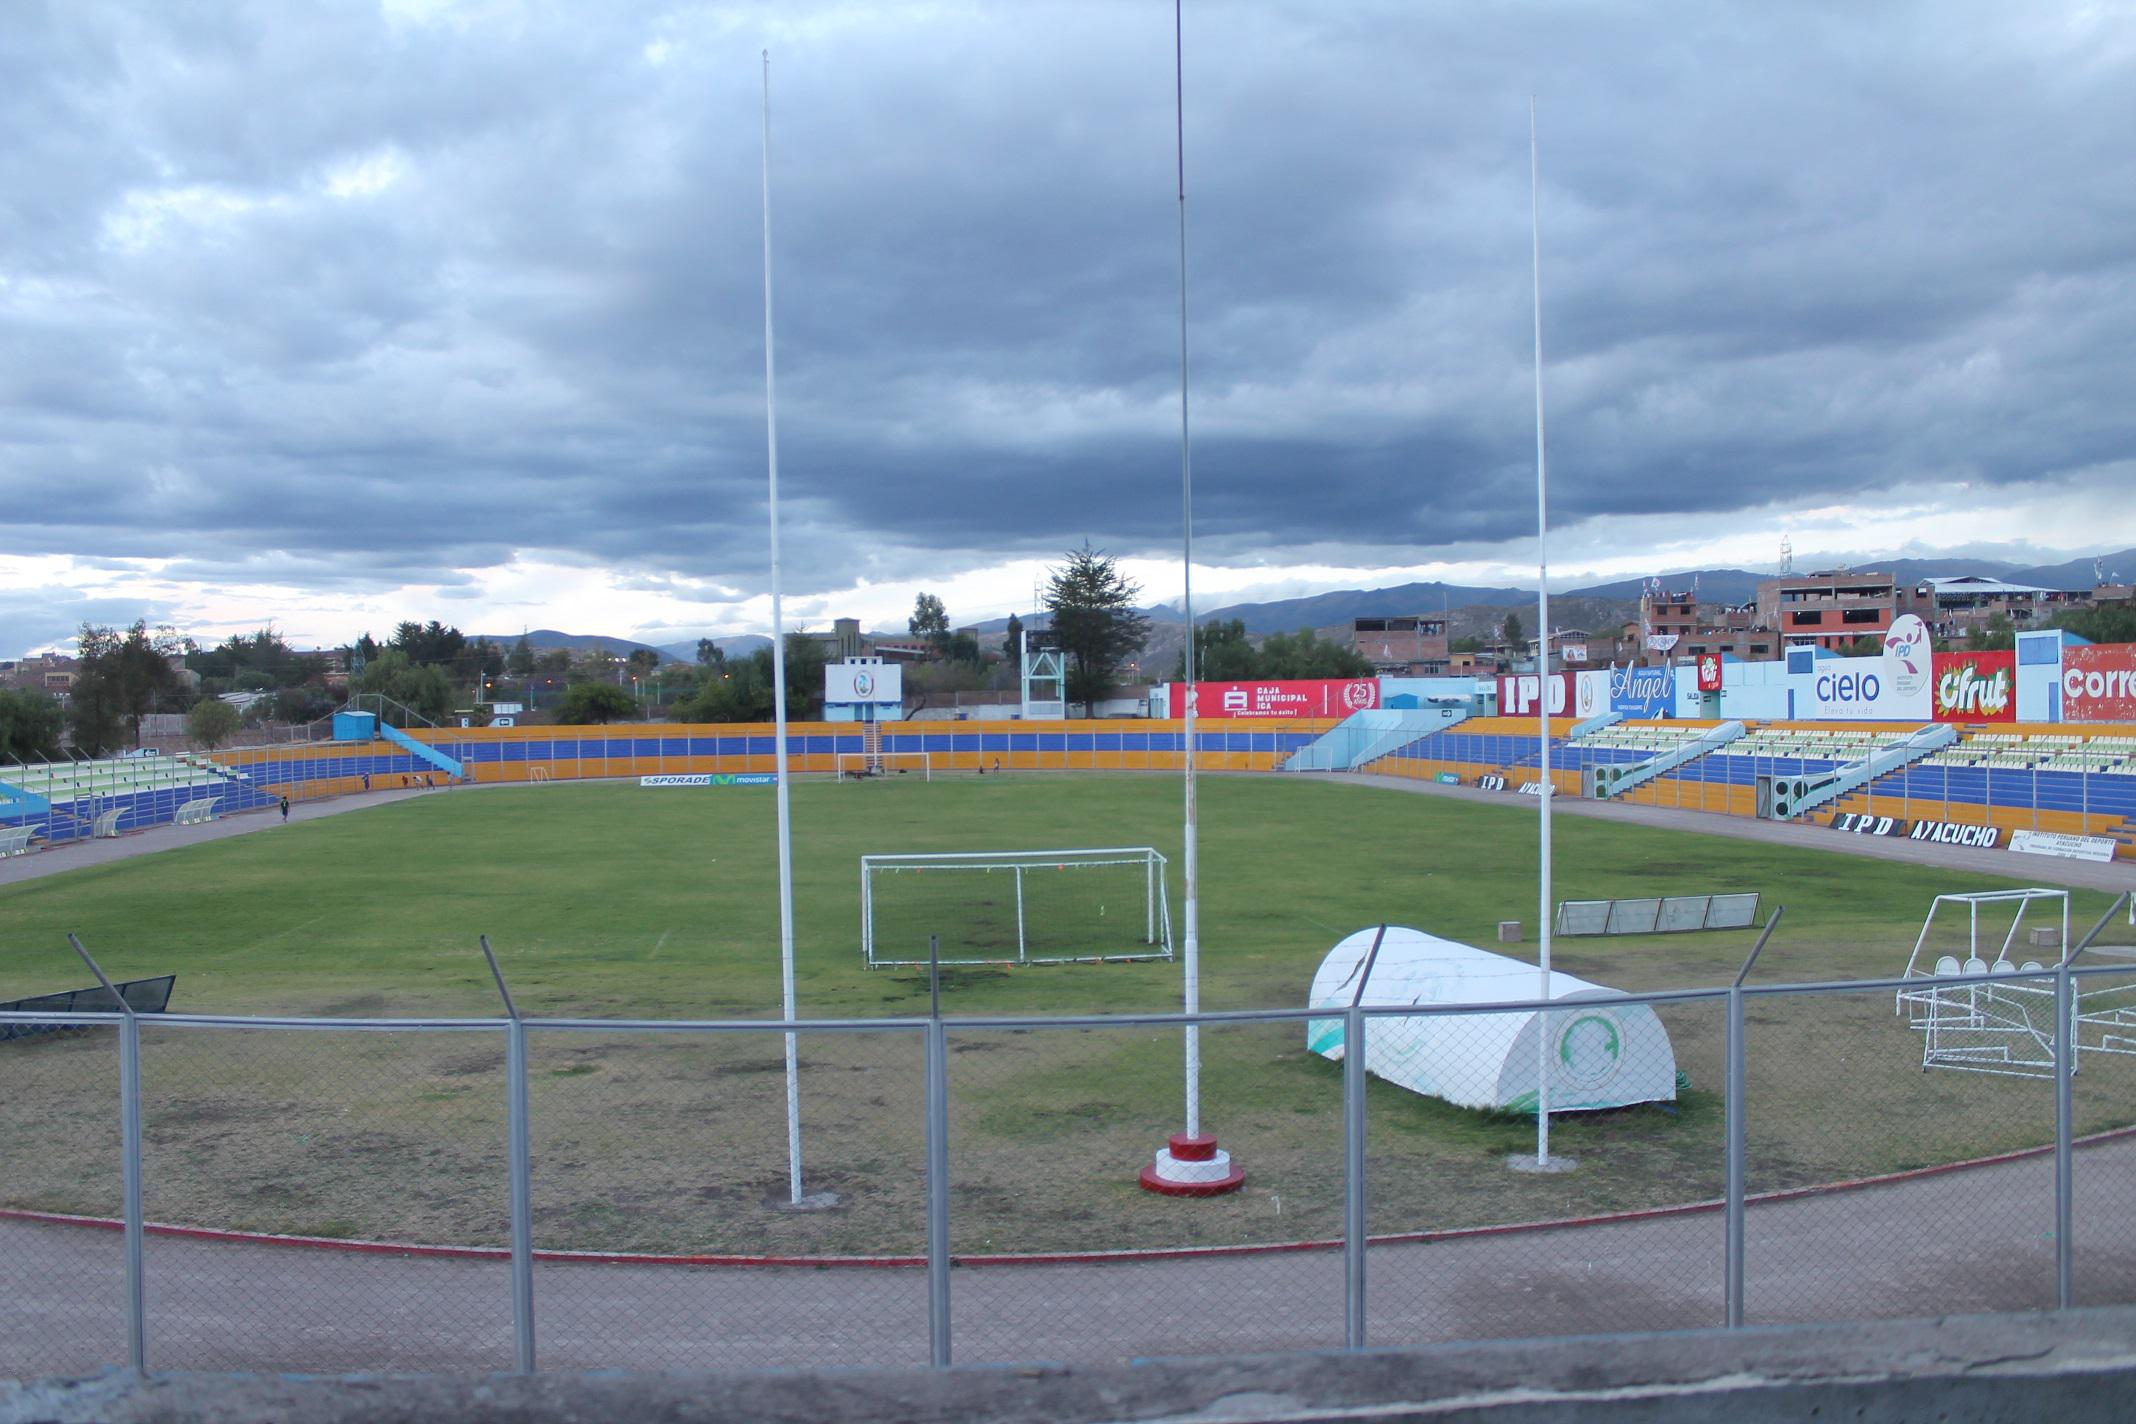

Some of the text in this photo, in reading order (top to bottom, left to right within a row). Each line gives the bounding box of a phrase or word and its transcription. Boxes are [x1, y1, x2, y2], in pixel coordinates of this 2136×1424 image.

[1895, 644, 1911, 657] IPD
[1353, 683, 1367, 698] 25
[1504, 674, 1566, 714] IPD
[1610, 657, 1673, 713] Angel
[1816, 671, 1880, 702] cielo
[1256, 694, 1308, 702] MUNICIPAL
[650, 776, 711, 784] SPORADE
[1481, 775, 1505, 791] IPD
[1838, 813, 1894, 835] IPD
[1911, 820, 1997, 848] AYACUCHO
